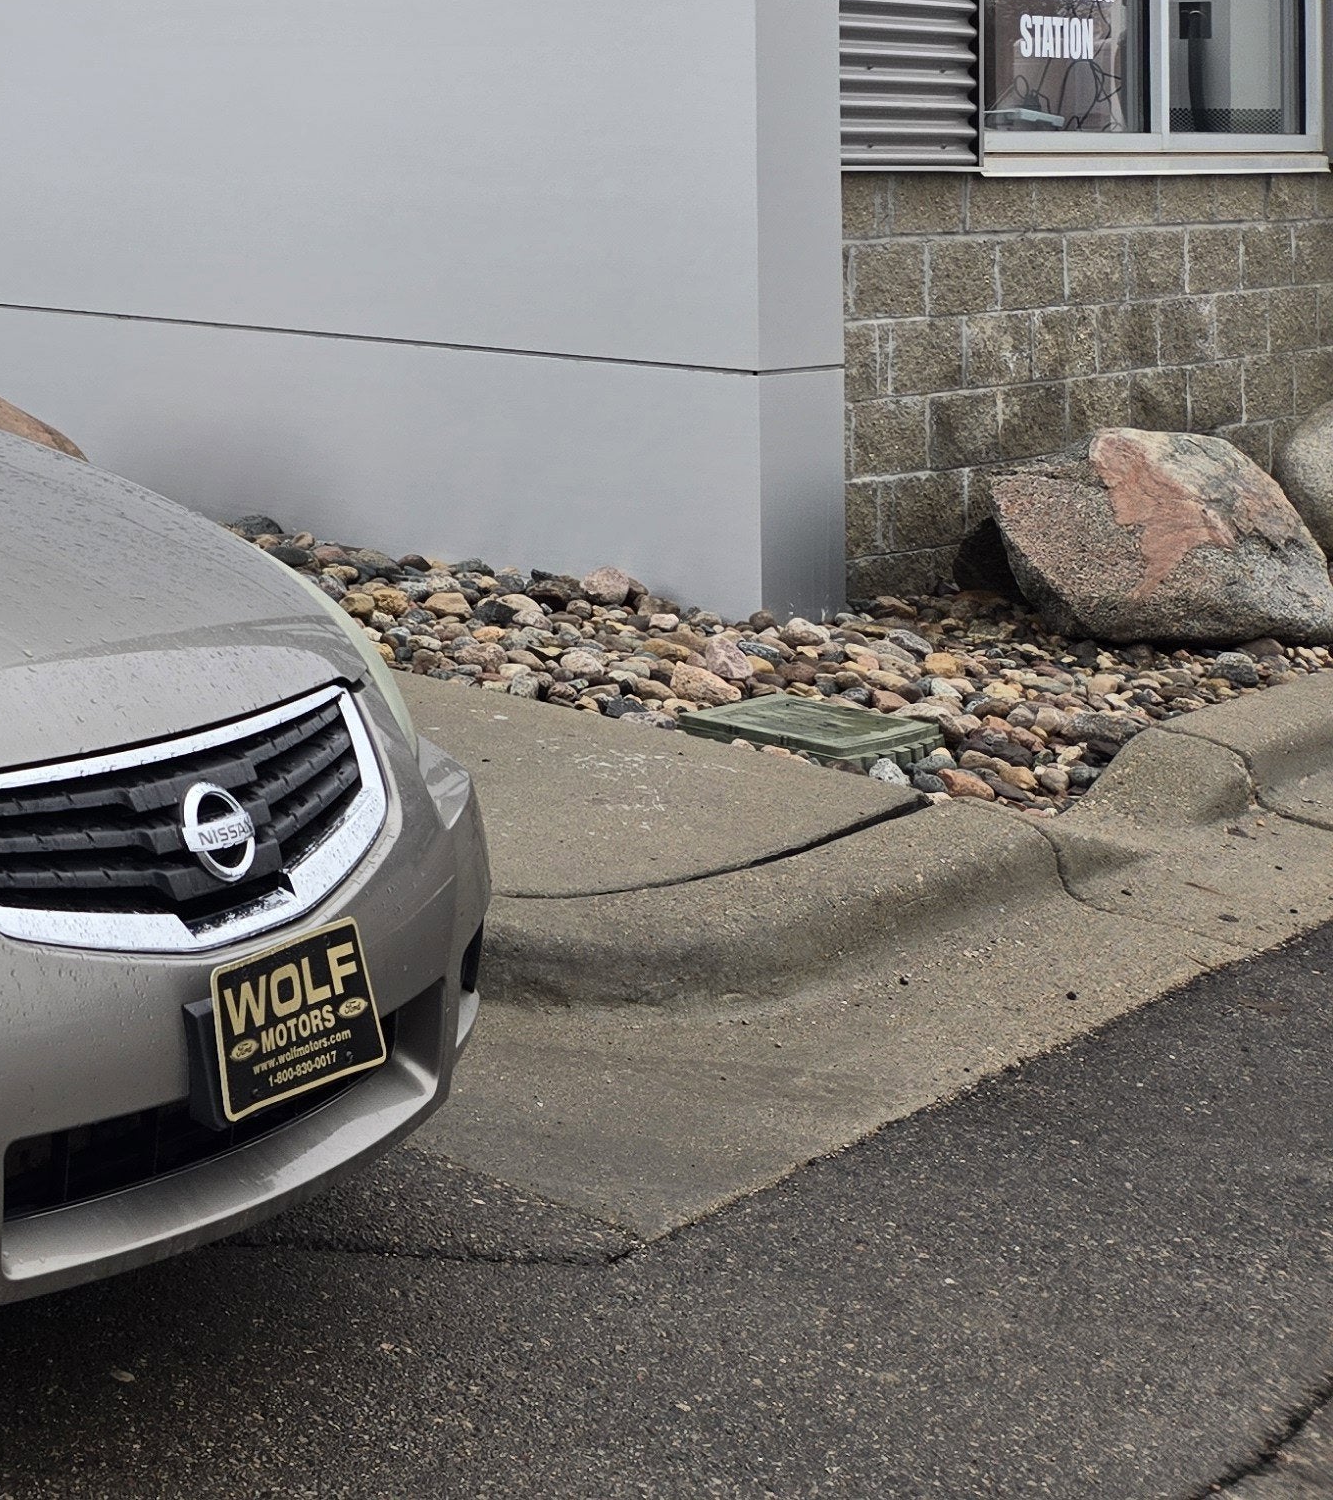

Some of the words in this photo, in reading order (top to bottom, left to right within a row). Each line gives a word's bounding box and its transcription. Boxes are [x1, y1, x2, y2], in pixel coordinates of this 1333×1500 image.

[1019, 14, 1094, 60] STATION
[197, 816, 253, 846] NISSAN
[223, 941, 358, 1036] WOLF
[252, 1029, 352, 1075] www.wolfmotors.com
[260, 1004, 336, 1054] MOTORS
[268, 1050, 337, 1088] 1-800-830-0017
